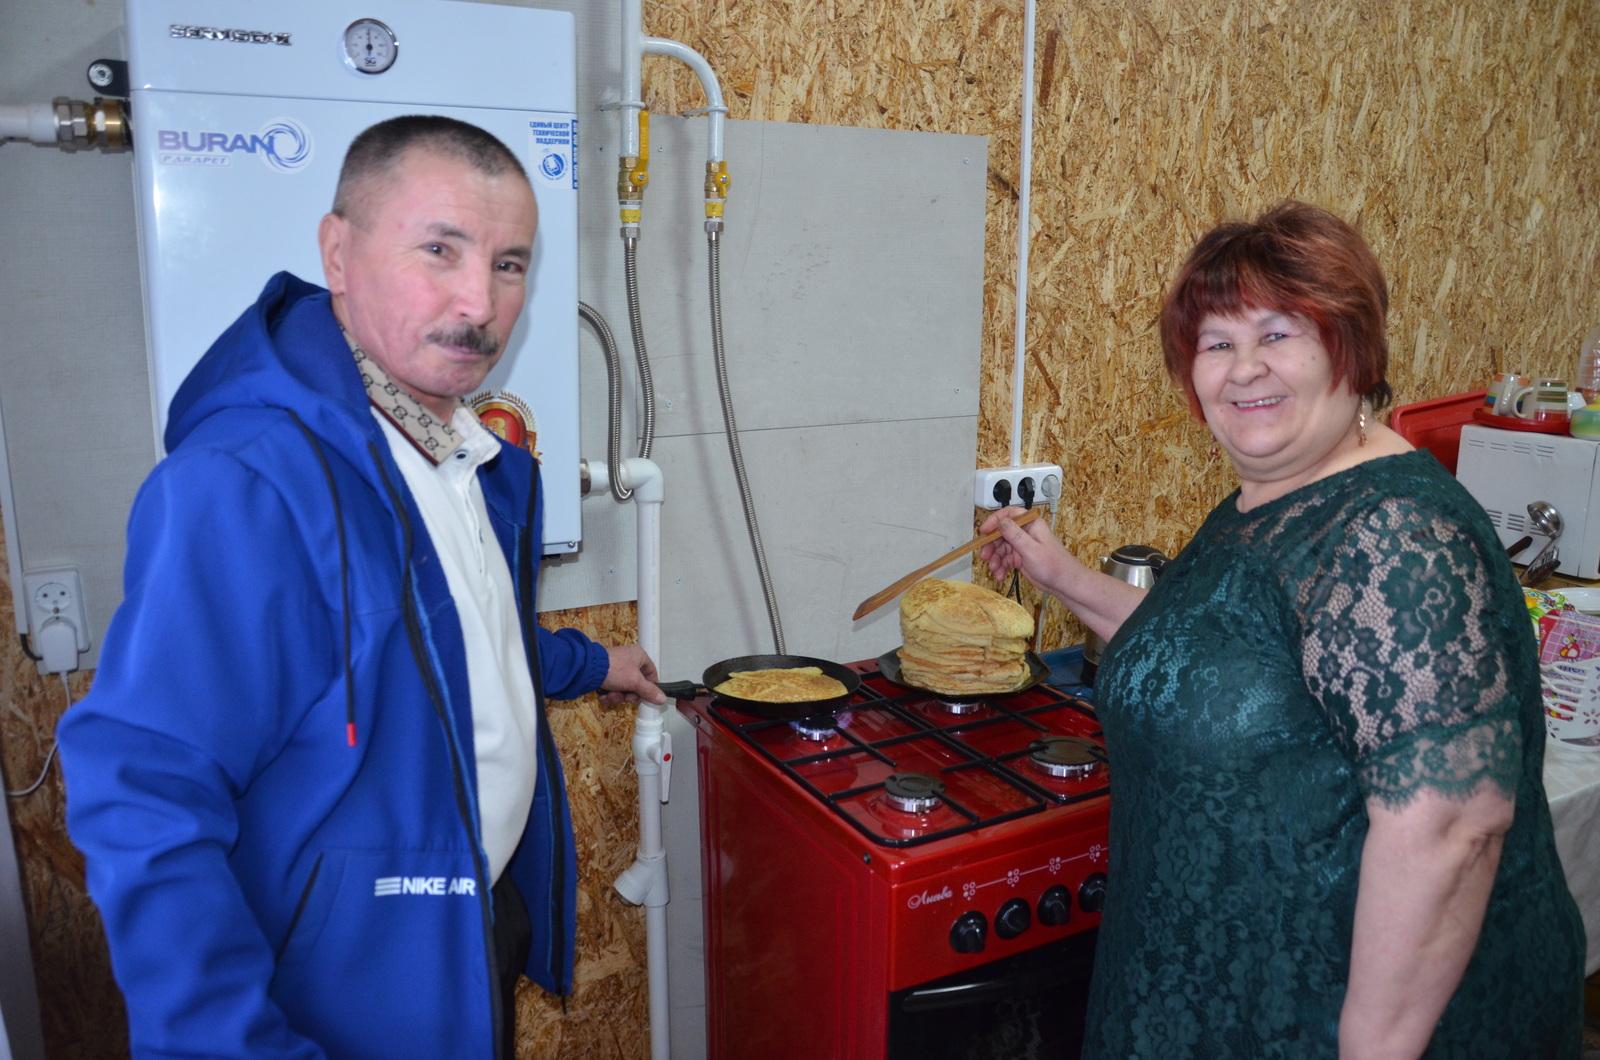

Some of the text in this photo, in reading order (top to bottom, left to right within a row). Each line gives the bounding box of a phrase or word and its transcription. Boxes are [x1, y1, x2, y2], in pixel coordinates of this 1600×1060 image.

[533, 129, 570, 137] ТЕХНИЧЕСКОЙ
[158, 130, 275, 155] BURAN
[536, 137, 570, 145] ПОДДЕРЖКИ
[163, 155, 227, 166] PARAPET
[402, 877, 476, 896] NIKE AIR
